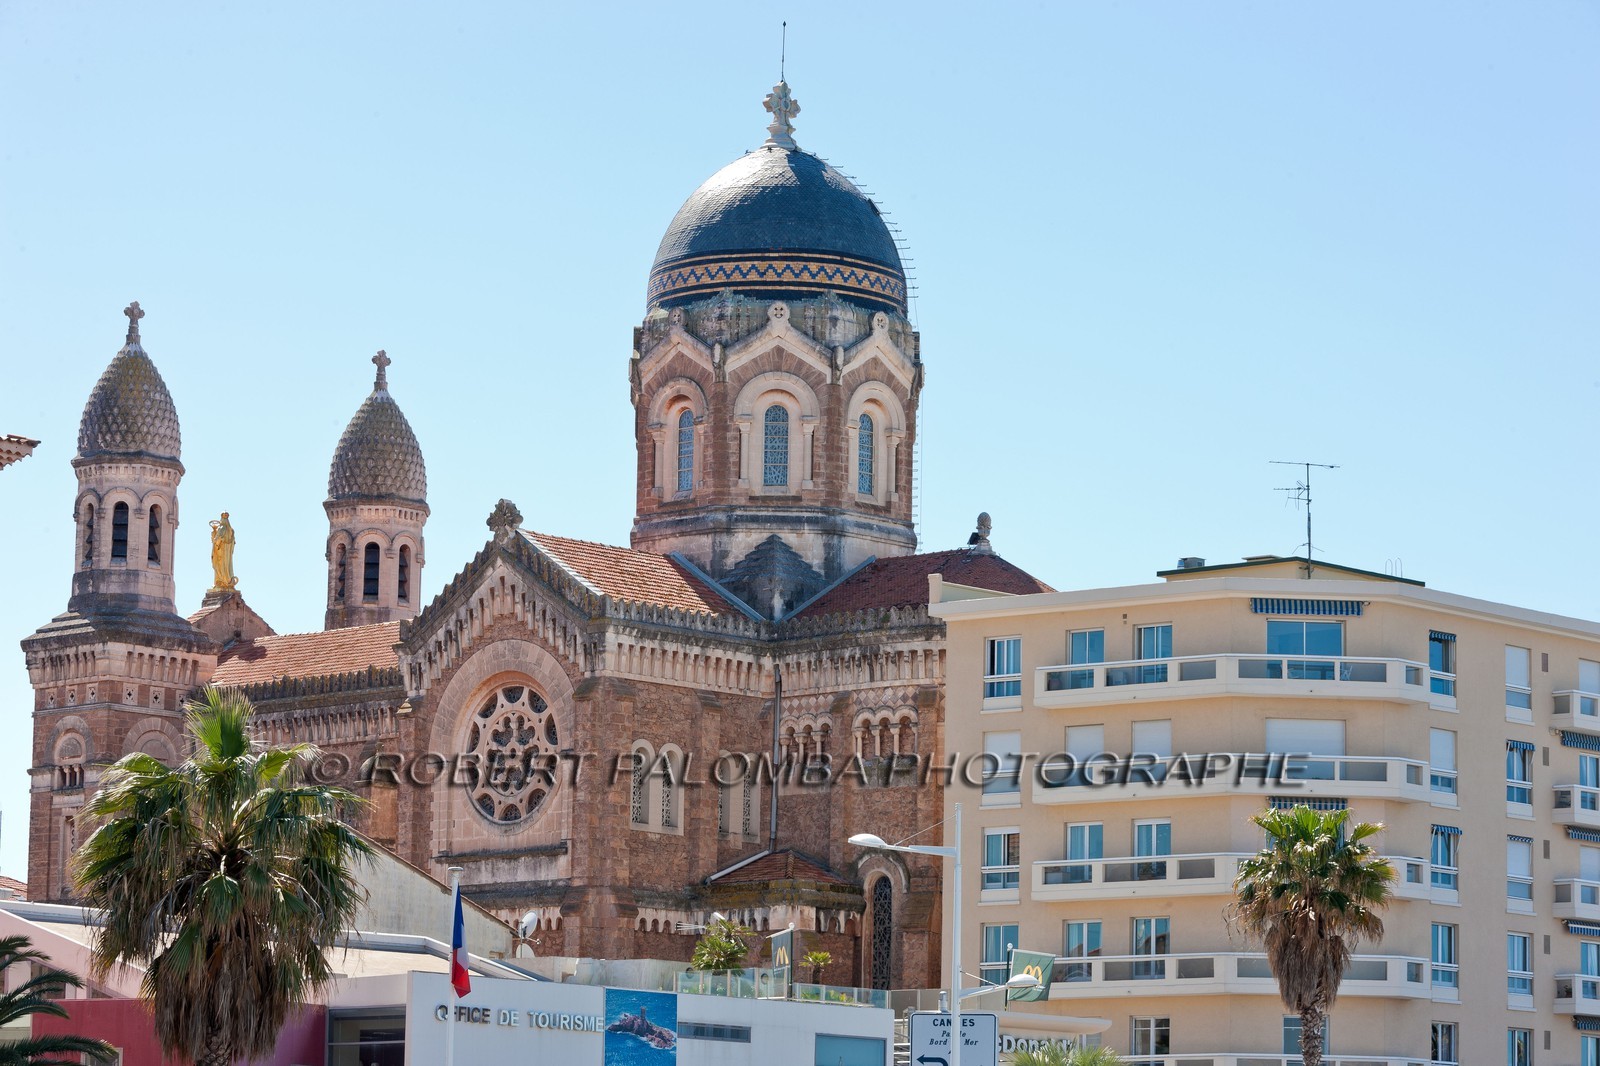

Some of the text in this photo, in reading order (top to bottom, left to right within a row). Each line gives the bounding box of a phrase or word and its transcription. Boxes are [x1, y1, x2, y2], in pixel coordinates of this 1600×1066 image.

[497, 1009, 520, 1027] DE
[527, 1011, 604, 1033] TOURISME
[932, 1018, 976, 1027] CANES
[929, 1038, 979, 1046] Bord Mer
